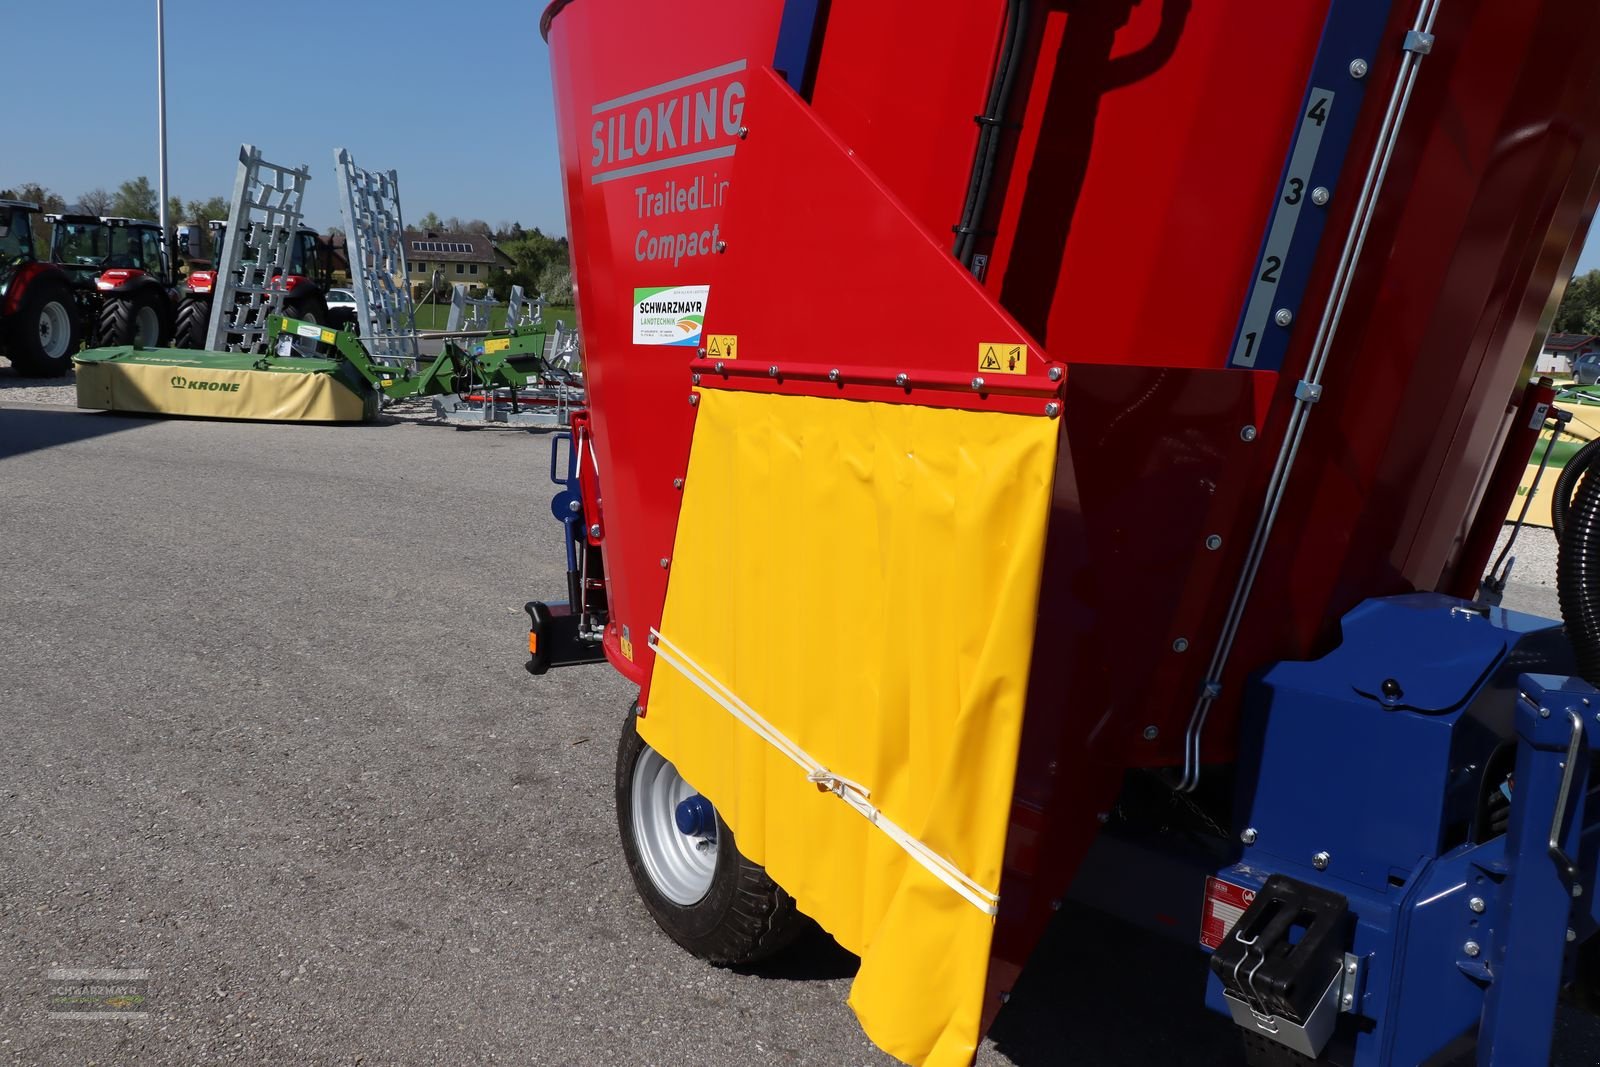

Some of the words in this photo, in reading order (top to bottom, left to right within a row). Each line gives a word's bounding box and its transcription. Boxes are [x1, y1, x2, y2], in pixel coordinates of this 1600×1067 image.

[591, 81, 746, 167] SILOKING
[1307, 98, 1328, 126] 4
[1284, 177, 1304, 205] 3
[634, 224, 720, 268] Compact
[1260, 256, 1281, 283] 2
[639, 301, 702, 314] SCHWARZMAYR
[640, 317, 676, 326] LANDTECHNIK
[1245, 332, 1257, 358] 1
[187, 380, 240, 392] KRONE
